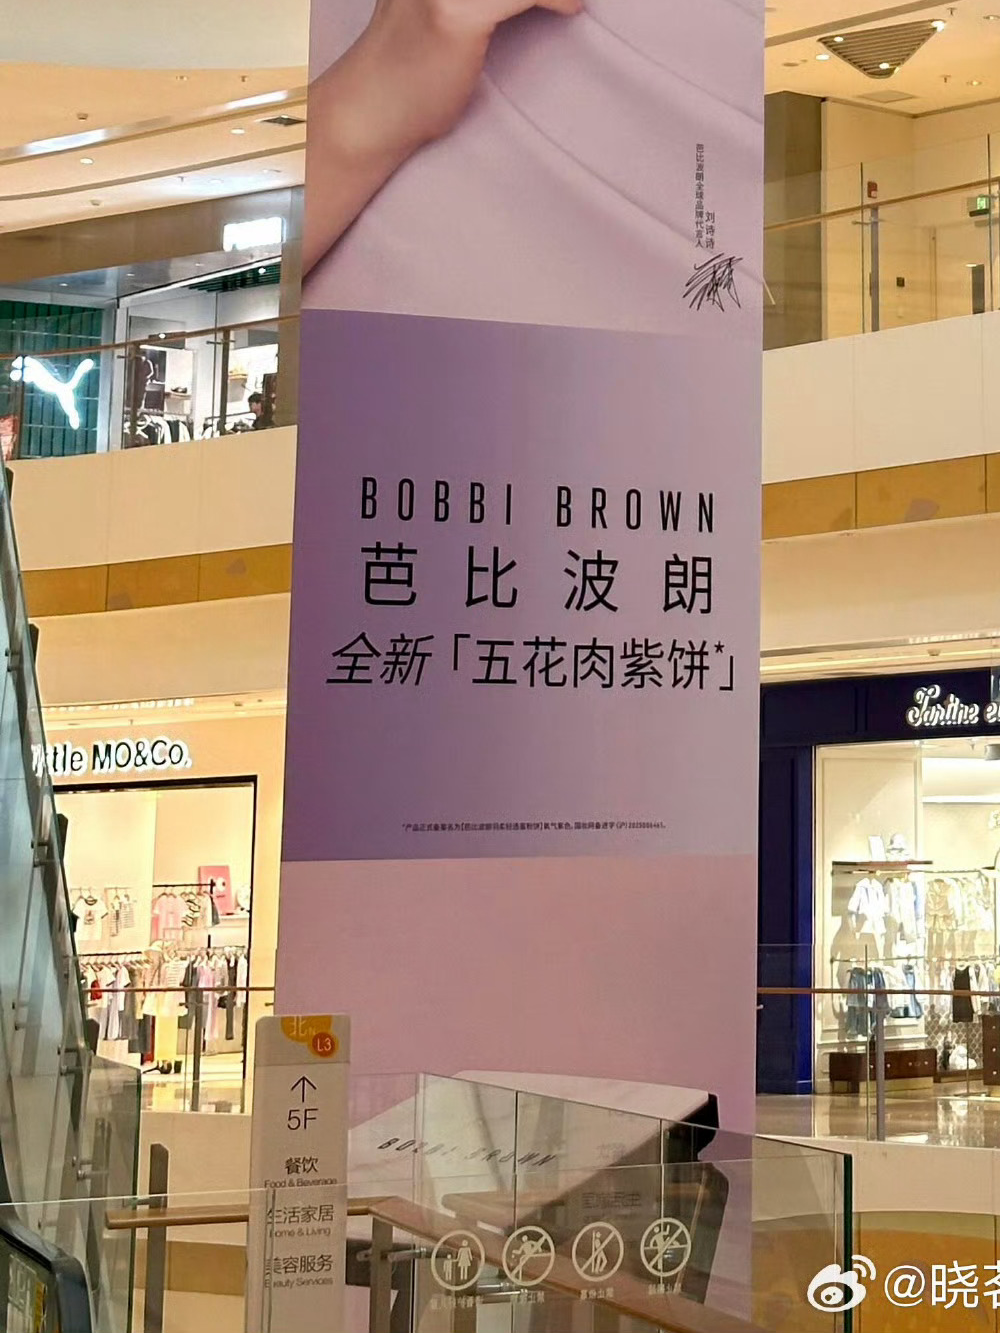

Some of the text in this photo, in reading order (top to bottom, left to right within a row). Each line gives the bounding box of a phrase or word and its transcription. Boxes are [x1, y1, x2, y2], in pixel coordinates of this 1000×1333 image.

[705, 211, 716, 249] 刘诗诗
[360, 476, 715, 533] BOBBI BROWN
[360, 541, 716, 614] 芭比波朗
[289, 1016, 308, 1036] 北
[317, 1037, 332, 1052] L3
[287, 1108, 319, 1130] 5F
[285, 1156, 319, 1174] 餐饮
[267, 1204, 334, 1224] 生活家居
